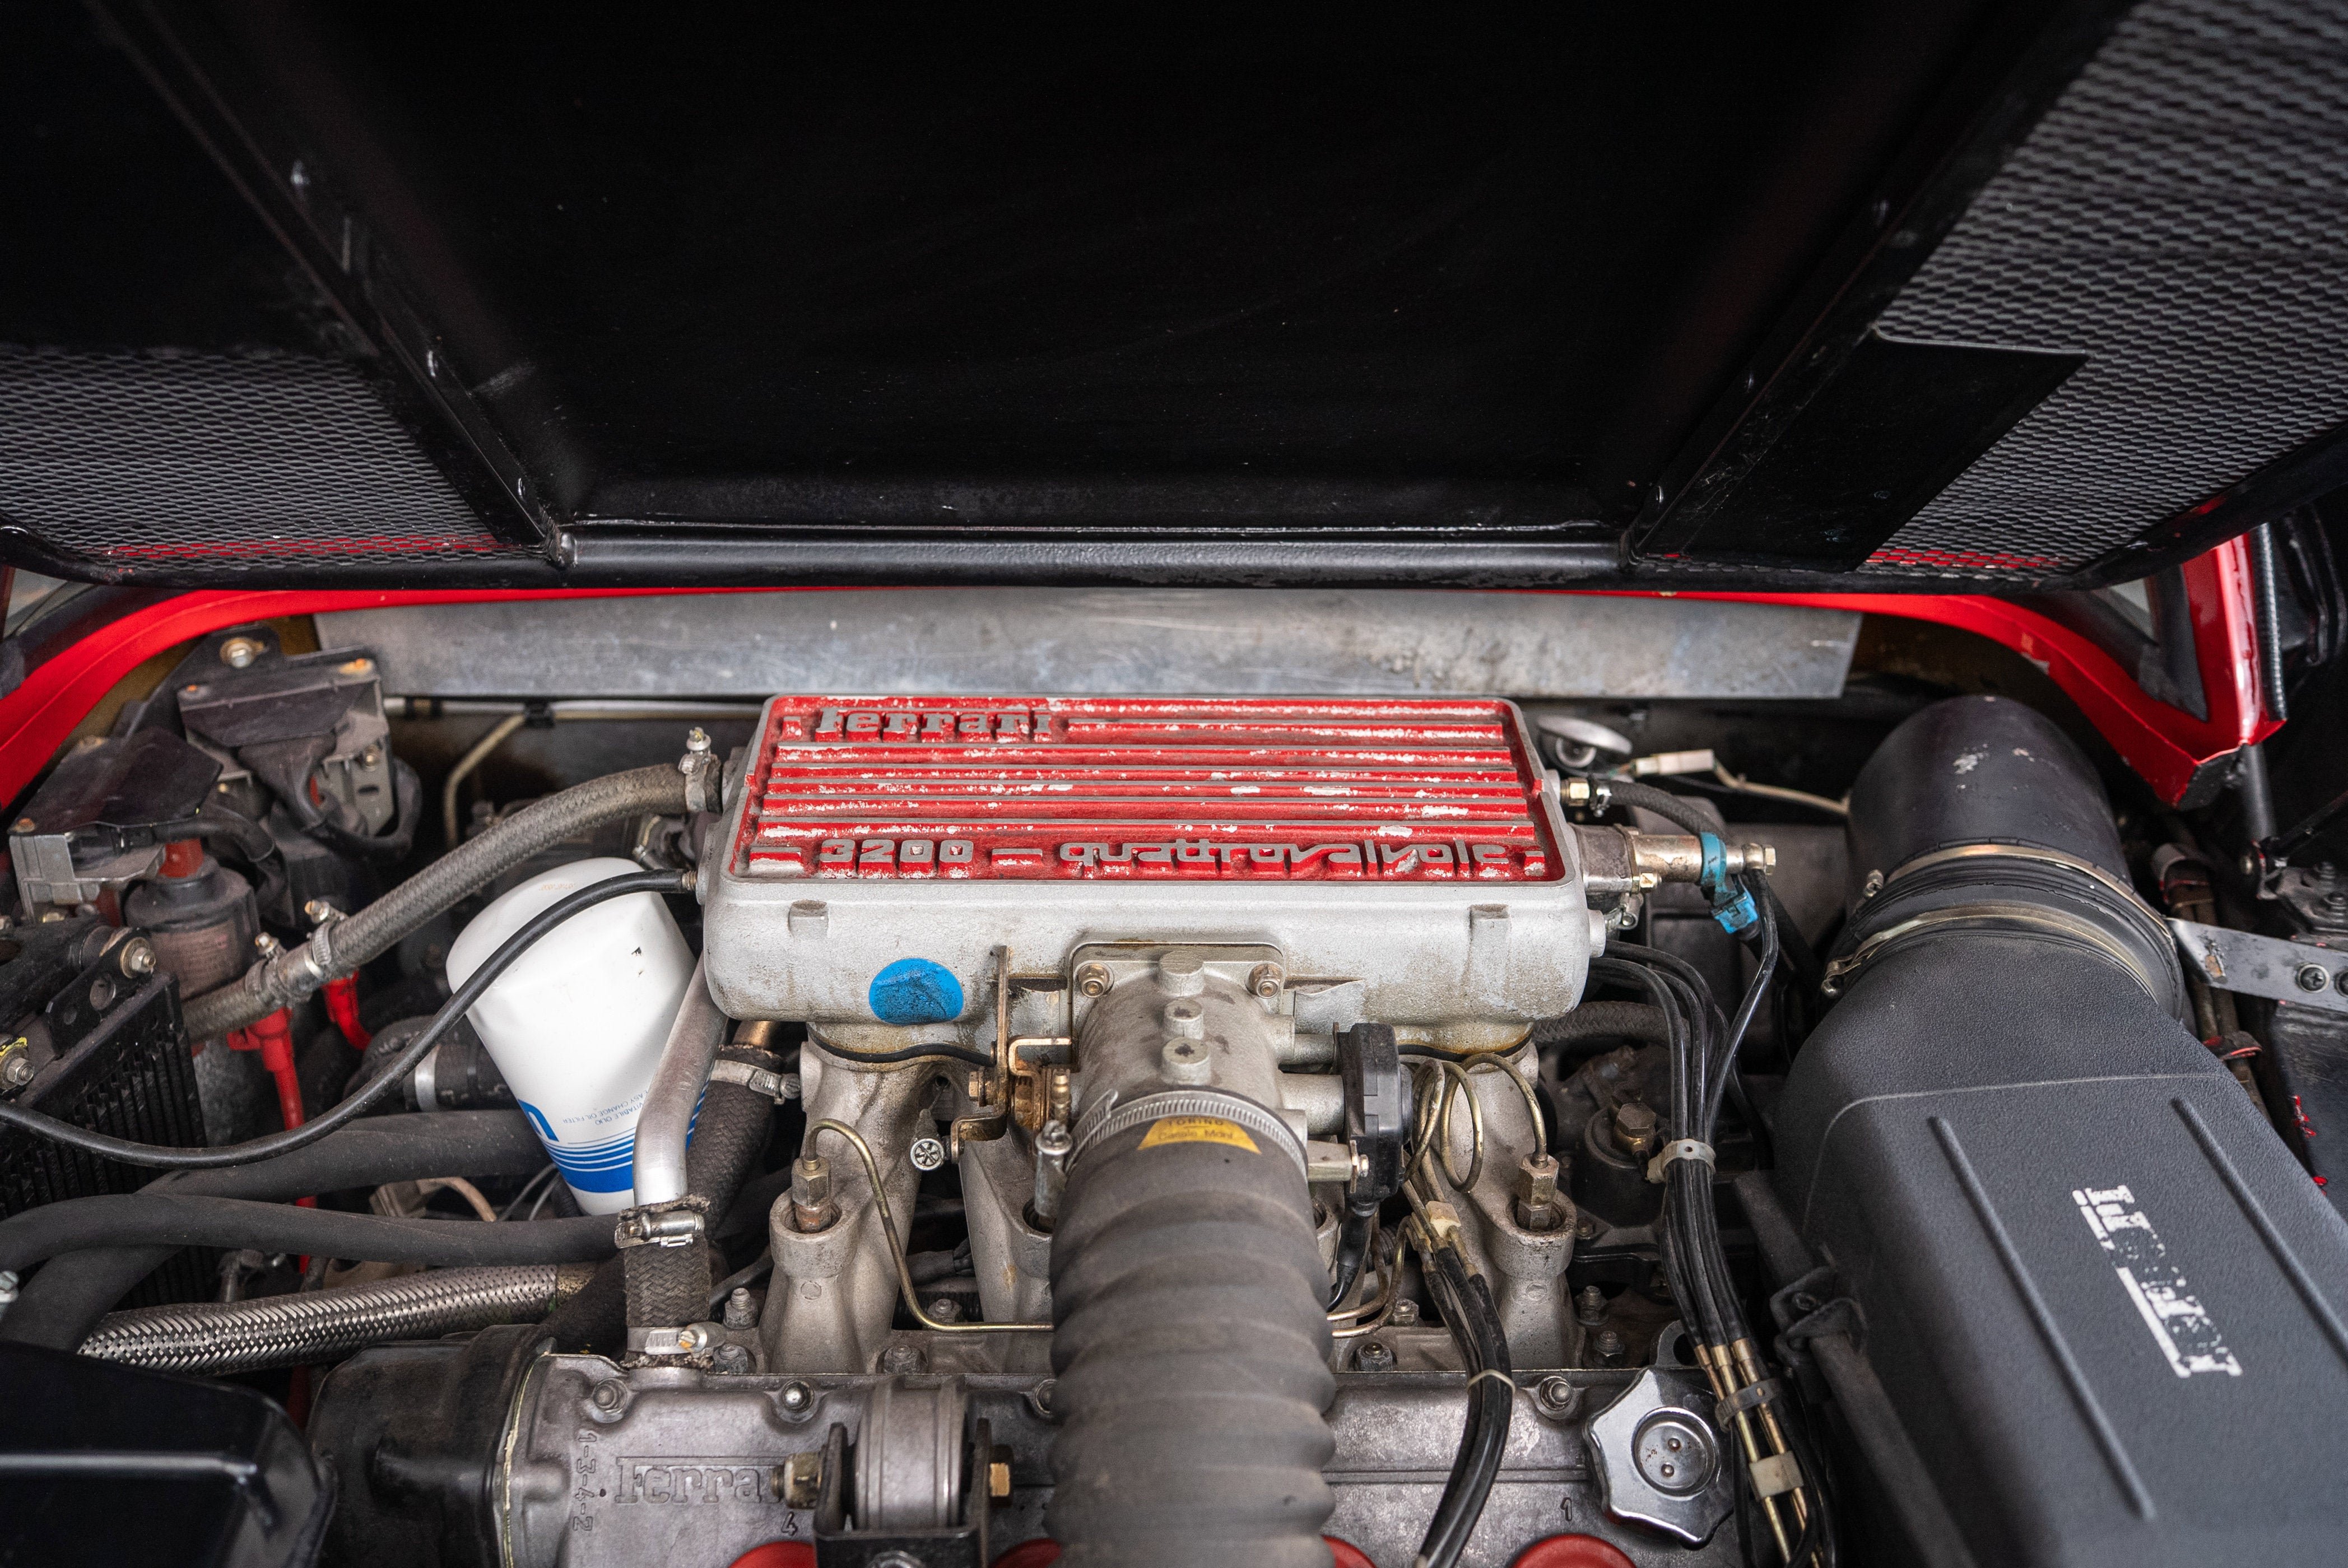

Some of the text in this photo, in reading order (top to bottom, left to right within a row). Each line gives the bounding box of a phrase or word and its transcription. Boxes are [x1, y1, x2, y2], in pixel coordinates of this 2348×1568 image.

[815, 707, 1053, 734] Ferrari
[819, 837, 1509, 867] 3200 quattrovalvole
[595, 1116, 612, 1125] OLIO
[599, 1101, 629, 1116] CHANGE
[615, 1457, 785, 1505] Ferra
[780, 1511, 798, 1536] 4
